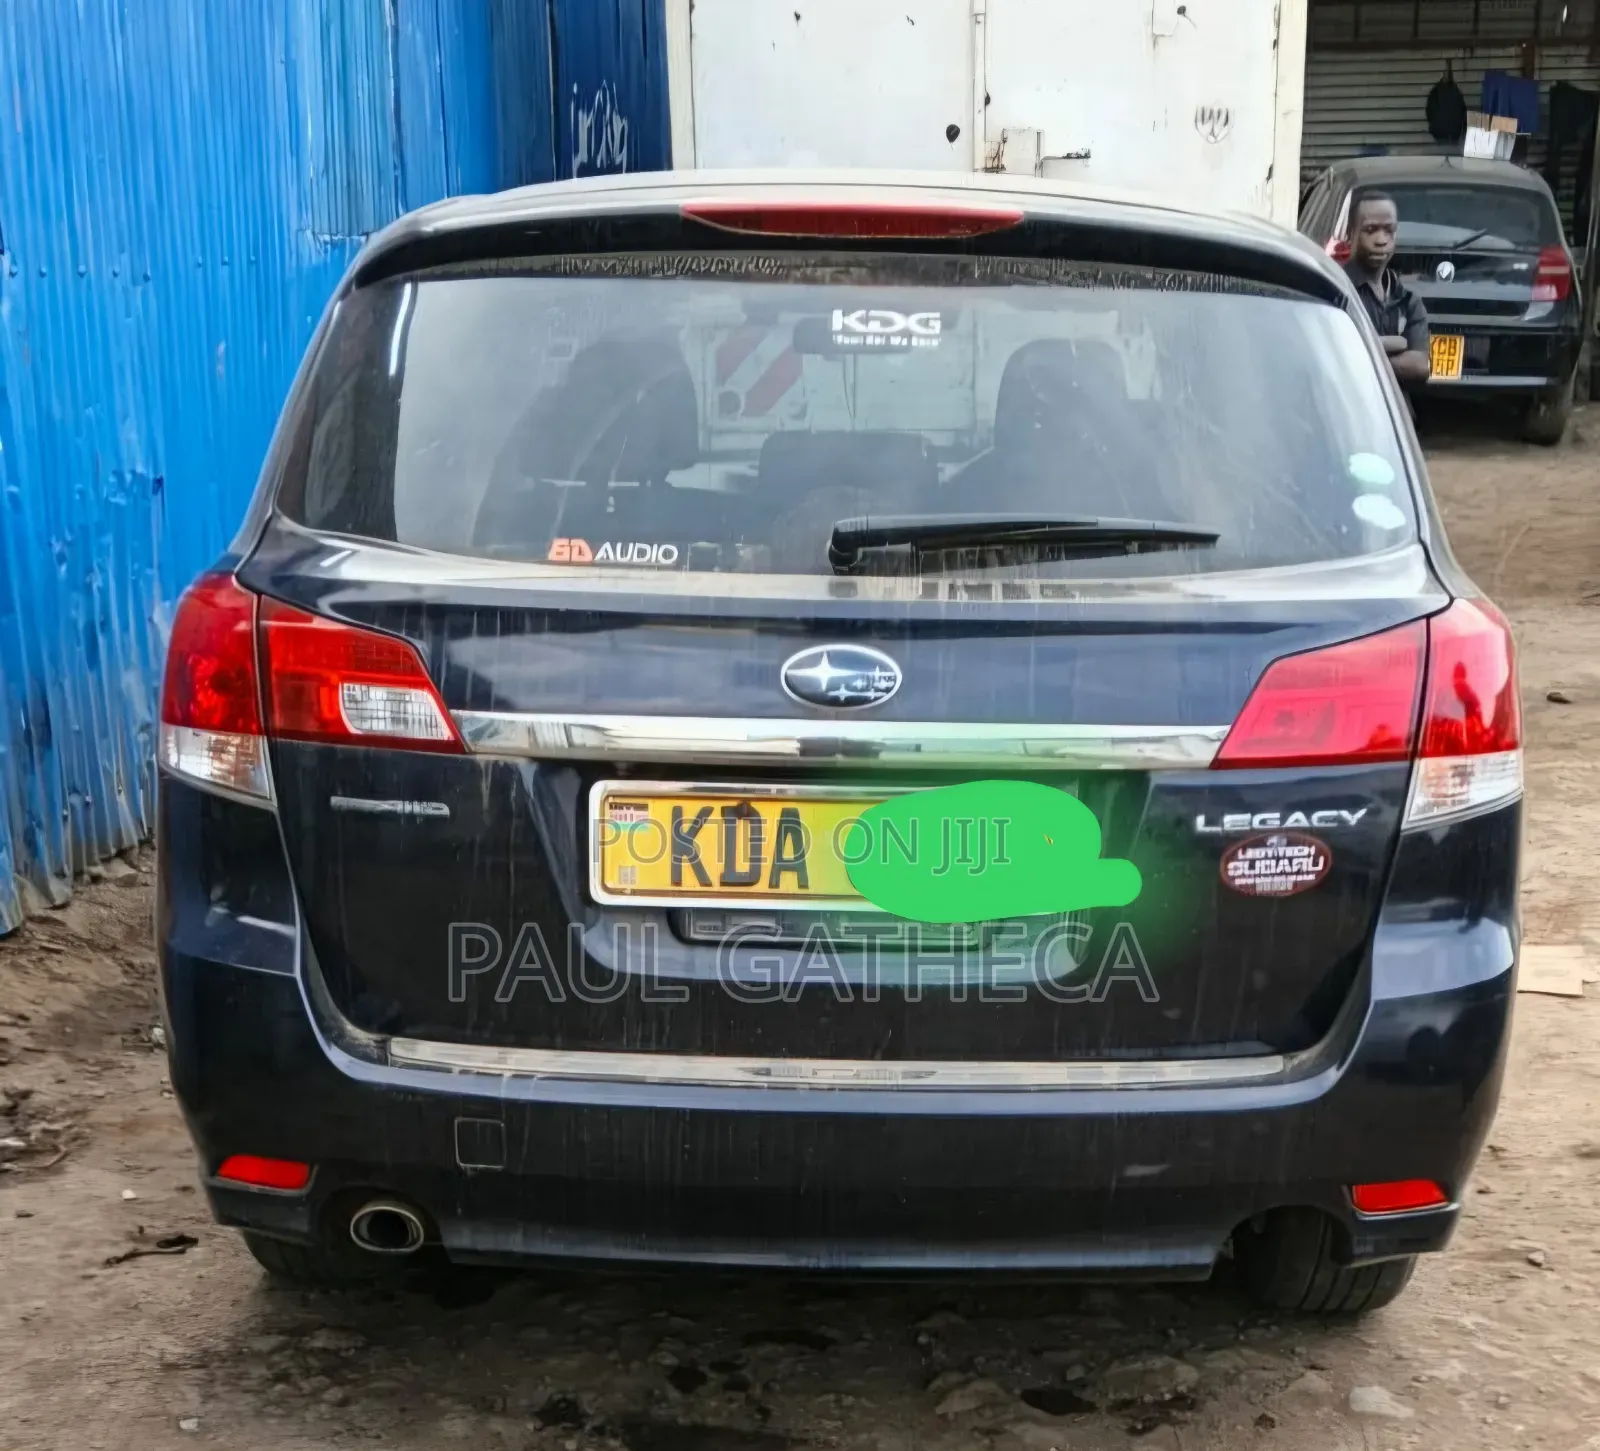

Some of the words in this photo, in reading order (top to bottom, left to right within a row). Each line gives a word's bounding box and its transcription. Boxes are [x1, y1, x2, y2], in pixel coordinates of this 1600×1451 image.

[832, 309, 941, 335] KDG
[594, 541, 679, 565] AUDIO
[1195, 806, 1368, 834] LEGACY
[670, 805, 810, 889] KDA
